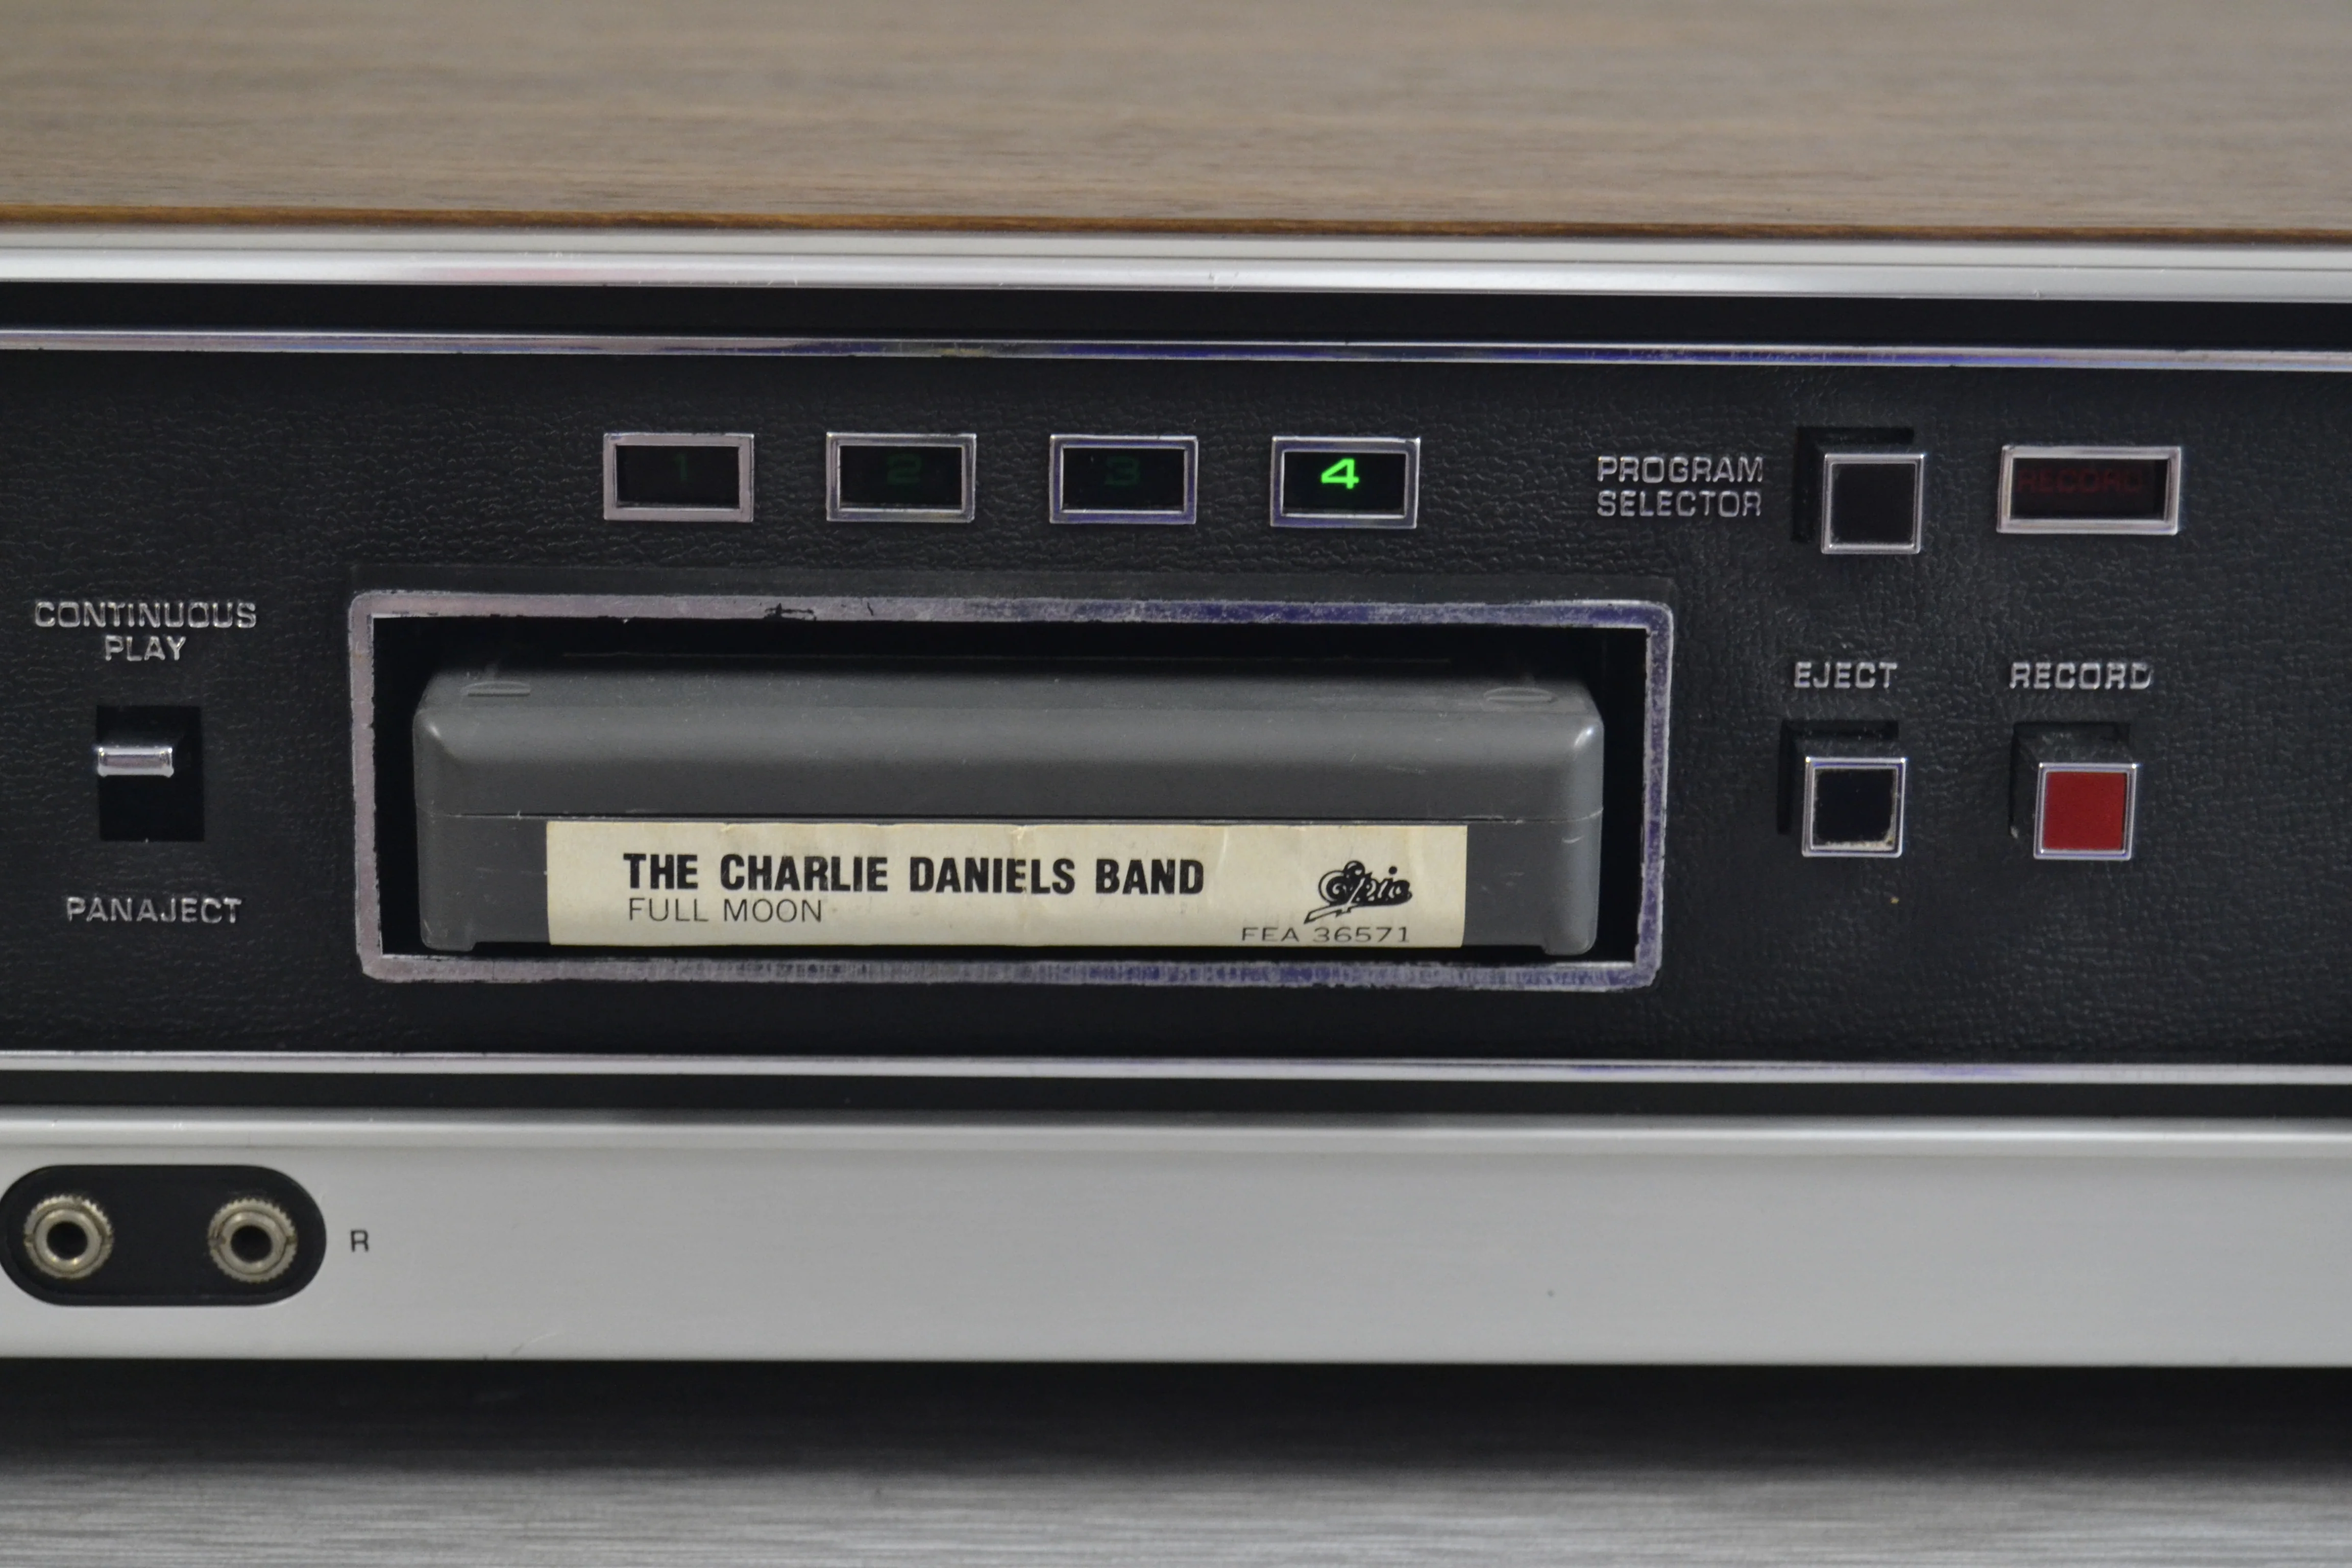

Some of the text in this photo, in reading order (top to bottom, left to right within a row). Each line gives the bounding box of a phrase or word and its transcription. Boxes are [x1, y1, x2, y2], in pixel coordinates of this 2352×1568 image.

[887, 453, 922, 485] 2
[1104, 455, 1141, 486] 3
[1320, 457, 1360, 489] 4
[1597, 456, 1763, 483] PROGRAM
[1597, 490, 1762, 517] SELECTOR
[34, 601, 257, 628] CONTINUOUS
[105, 635, 186, 661] PLAY
[1794, 662, 1898, 688] EJECT
[2009, 662, 2153, 690] RECORD
[623, 853, 1204, 895] THE CHARLIE DANIELS BAND
[1304, 860, 1413, 924] Epic
[65, 897, 242, 923] PANAJECT
[628, 898, 822, 922] FULL MOON
[1241, 926, 1410, 943] FEA 36571
[350, 1230, 370, 1252] R
